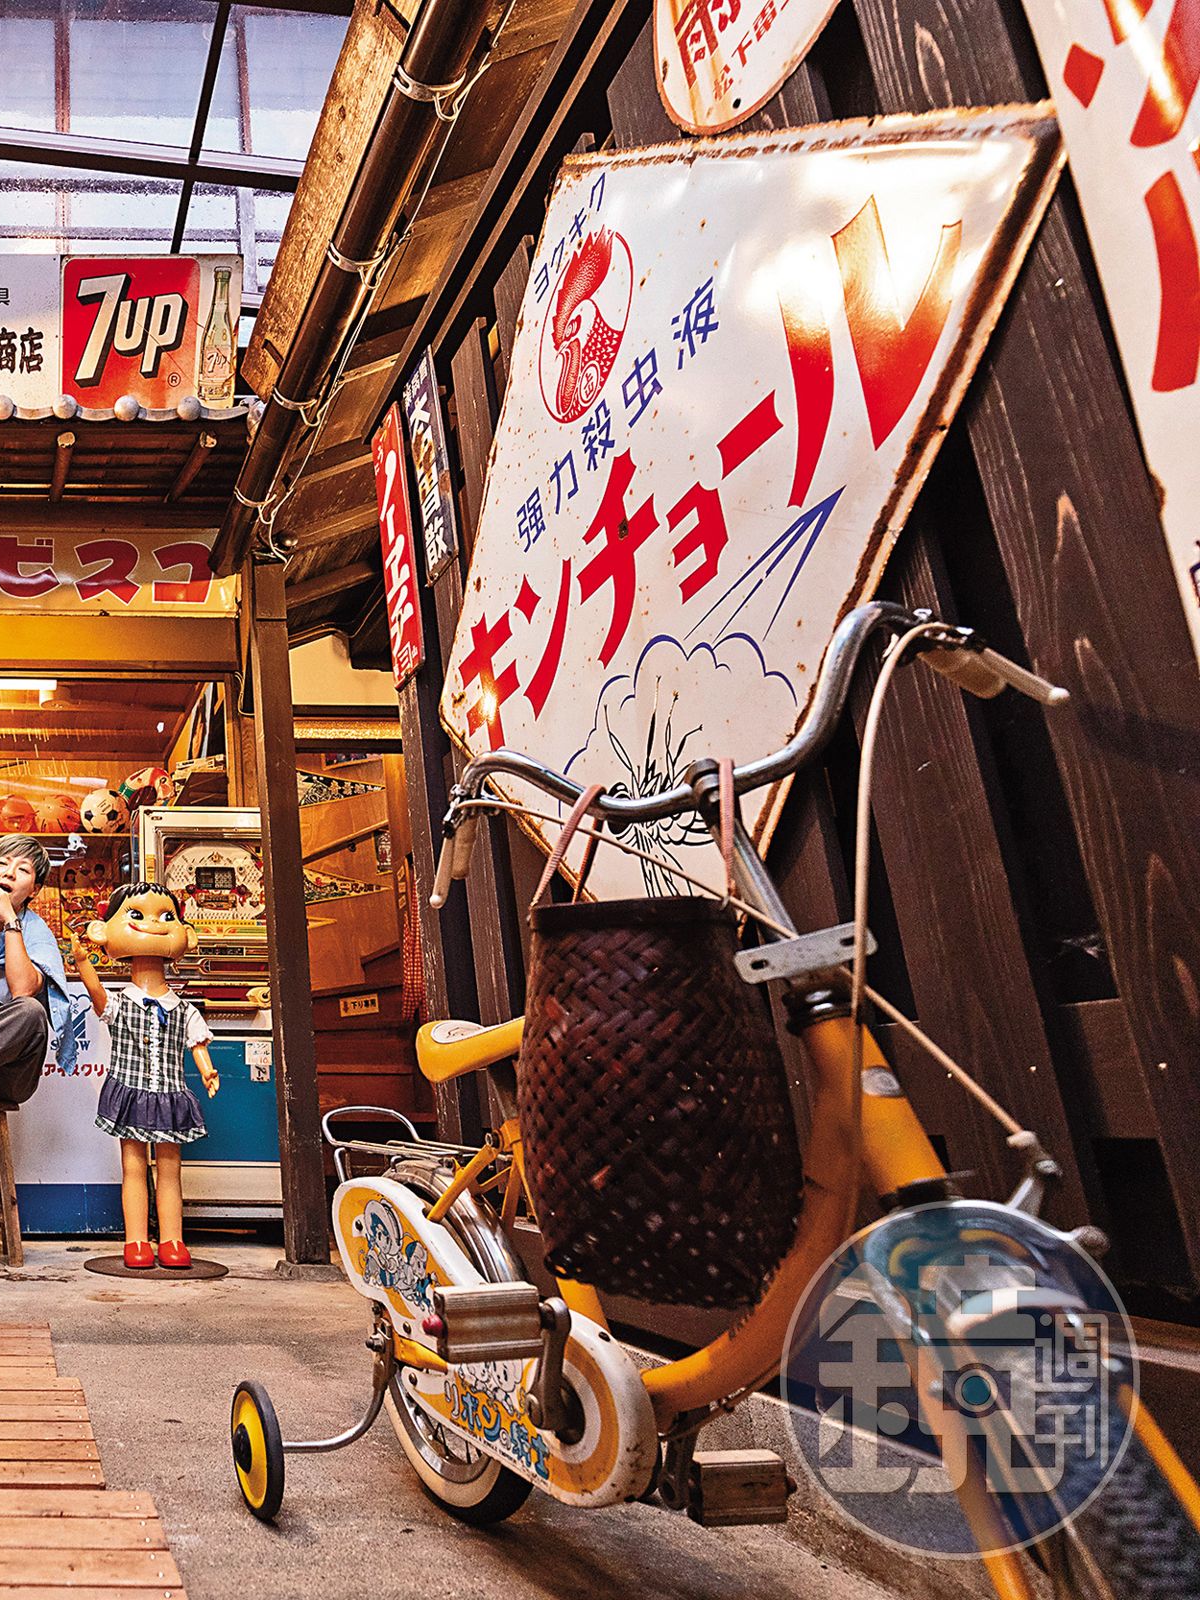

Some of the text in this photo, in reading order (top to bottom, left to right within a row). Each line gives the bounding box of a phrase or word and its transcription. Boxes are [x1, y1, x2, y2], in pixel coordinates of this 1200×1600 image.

[534, 172, 606, 304] ヨクキク
[460, 193, 964, 752] キンチョール
